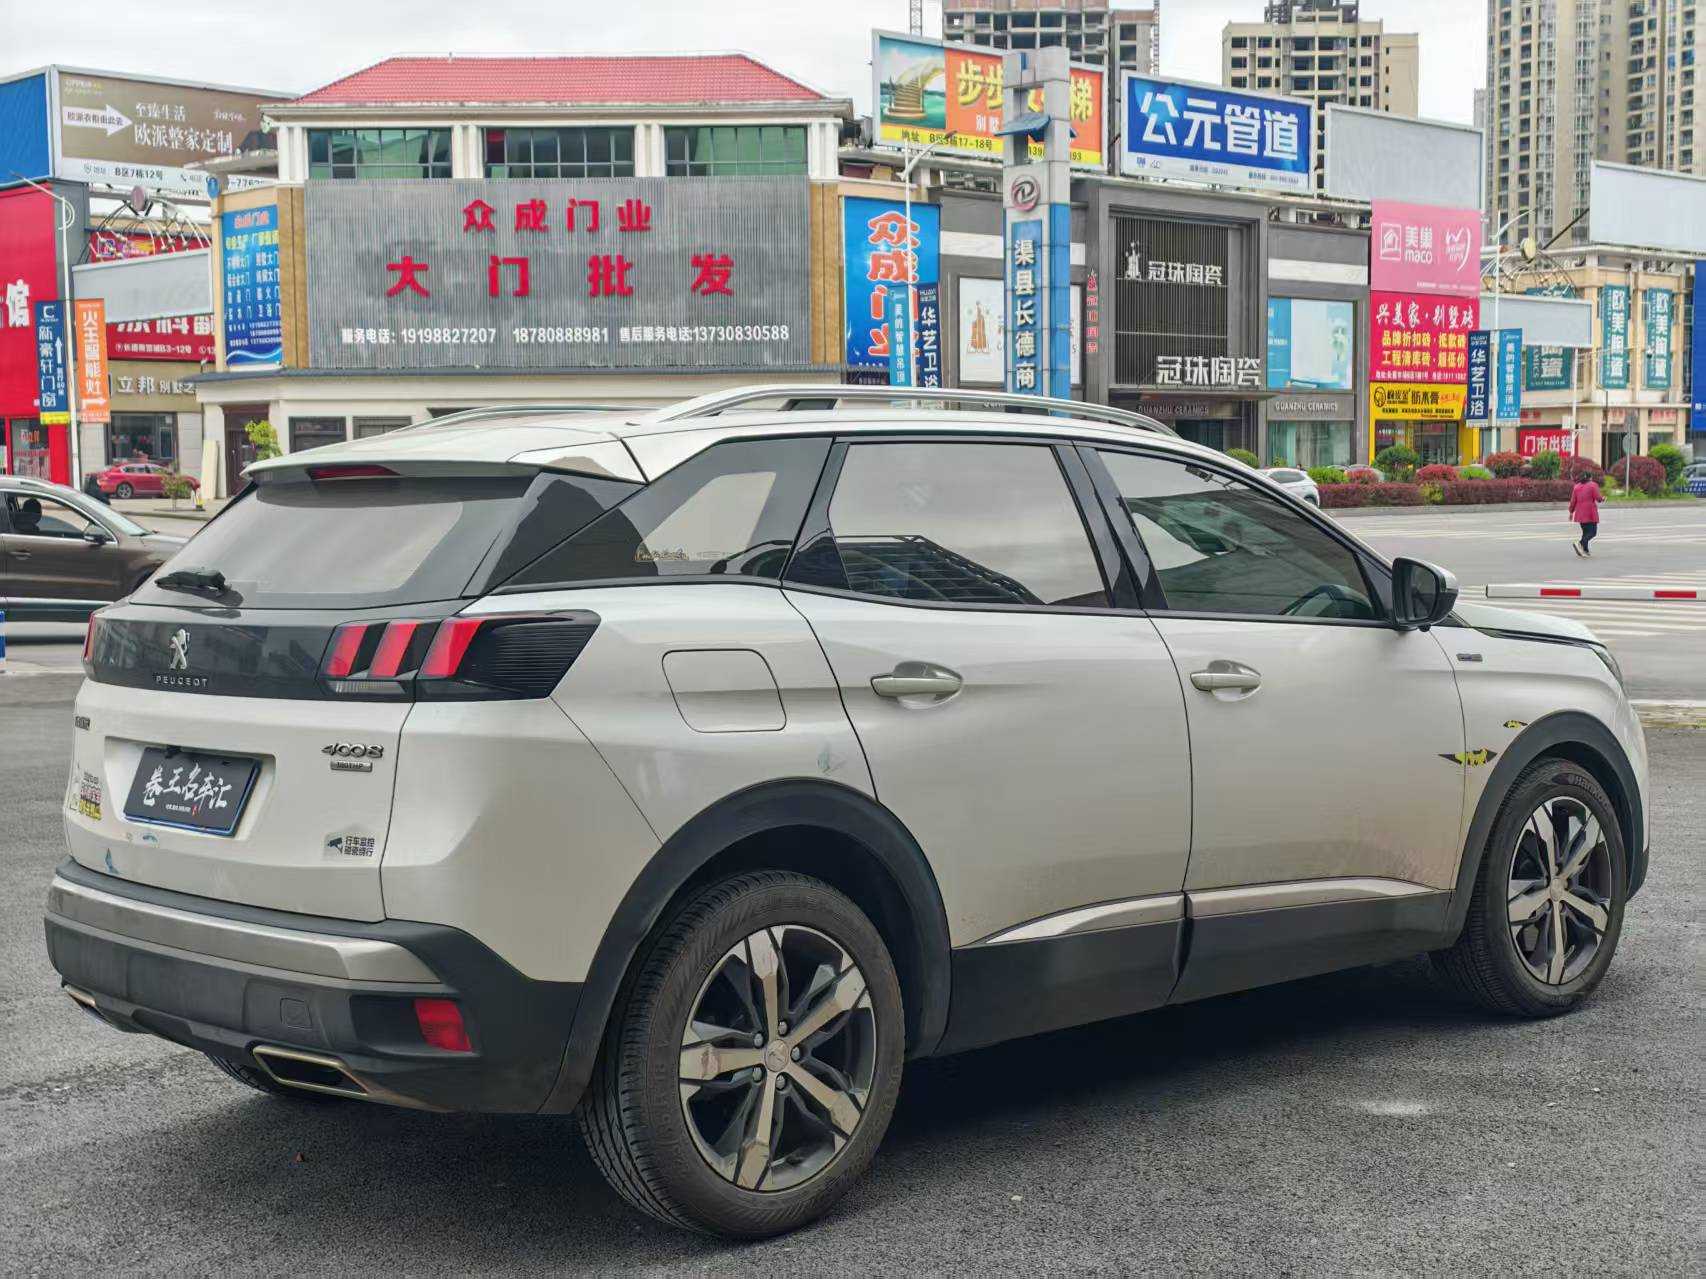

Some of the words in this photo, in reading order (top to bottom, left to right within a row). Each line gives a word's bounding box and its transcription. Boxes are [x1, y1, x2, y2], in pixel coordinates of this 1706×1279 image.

[134, 122, 233, 154] 欧派整家定制
[1140, 91, 1299, 160] 公元管道
[463, 198, 653, 234] 众成门业
[1405, 248, 1433, 264] maco
[386, 253, 736, 299] 大门批发
[1148, 260, 1223, 286] 冠珠陶瓷
[922, 306, 939, 388] 华艺卫浴
[117, 376, 155, 395] 立邦
[1157, 356, 1262, 386] 冠珠陶瓷
[1471, 348, 1486, 416] 华艺卫浴
[1275, 401, 1306, 411] GUANZHU
[1307, 402, 1339, 413] CERAMICS
[156, 675, 208, 688] PEUGEOT
[320, 743, 385, 759] 4008
